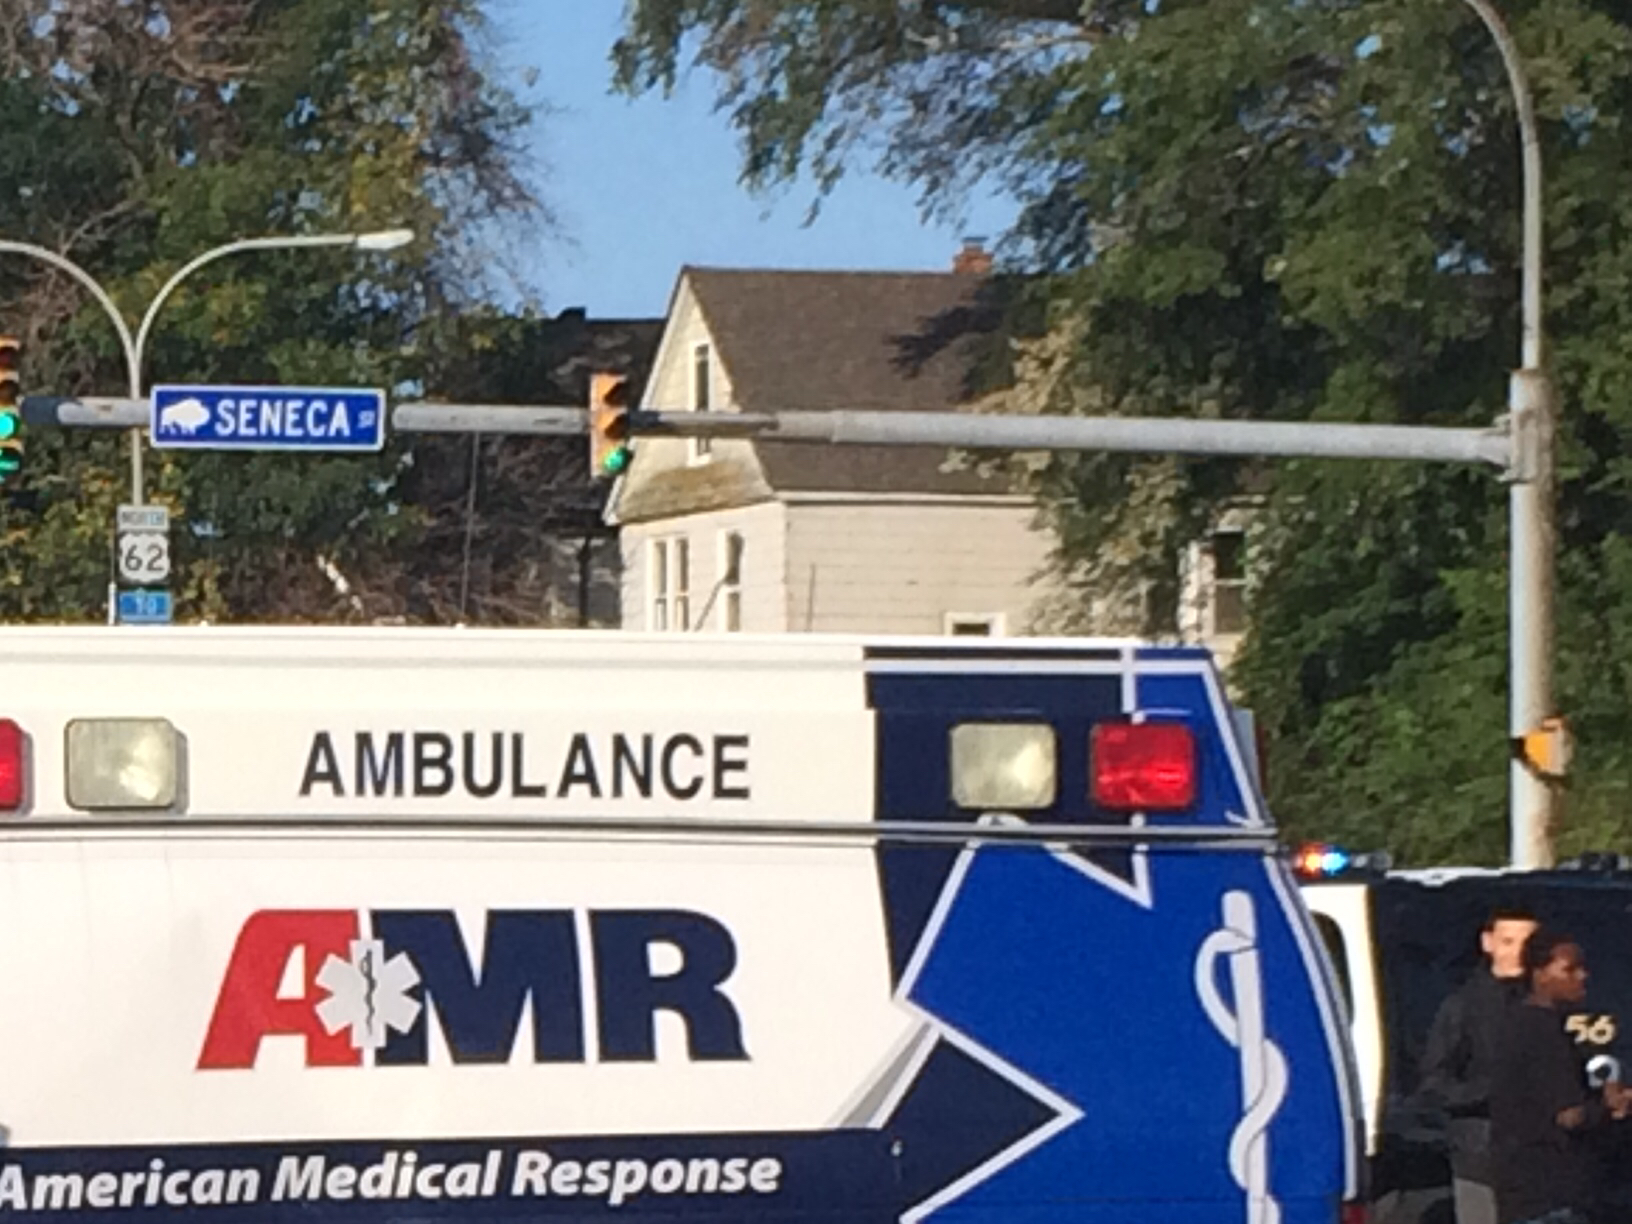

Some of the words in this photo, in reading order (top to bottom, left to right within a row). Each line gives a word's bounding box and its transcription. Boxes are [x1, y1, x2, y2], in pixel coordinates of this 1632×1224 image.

[215, 398, 351, 437] SENECA
[124, 544, 165, 572] 62
[298, 730, 751, 800] AMBULANCE
[195, 907, 753, 1071] AMR
[271, 1150, 502, 1201] Medical
[511, 1150, 782, 1207] Response
